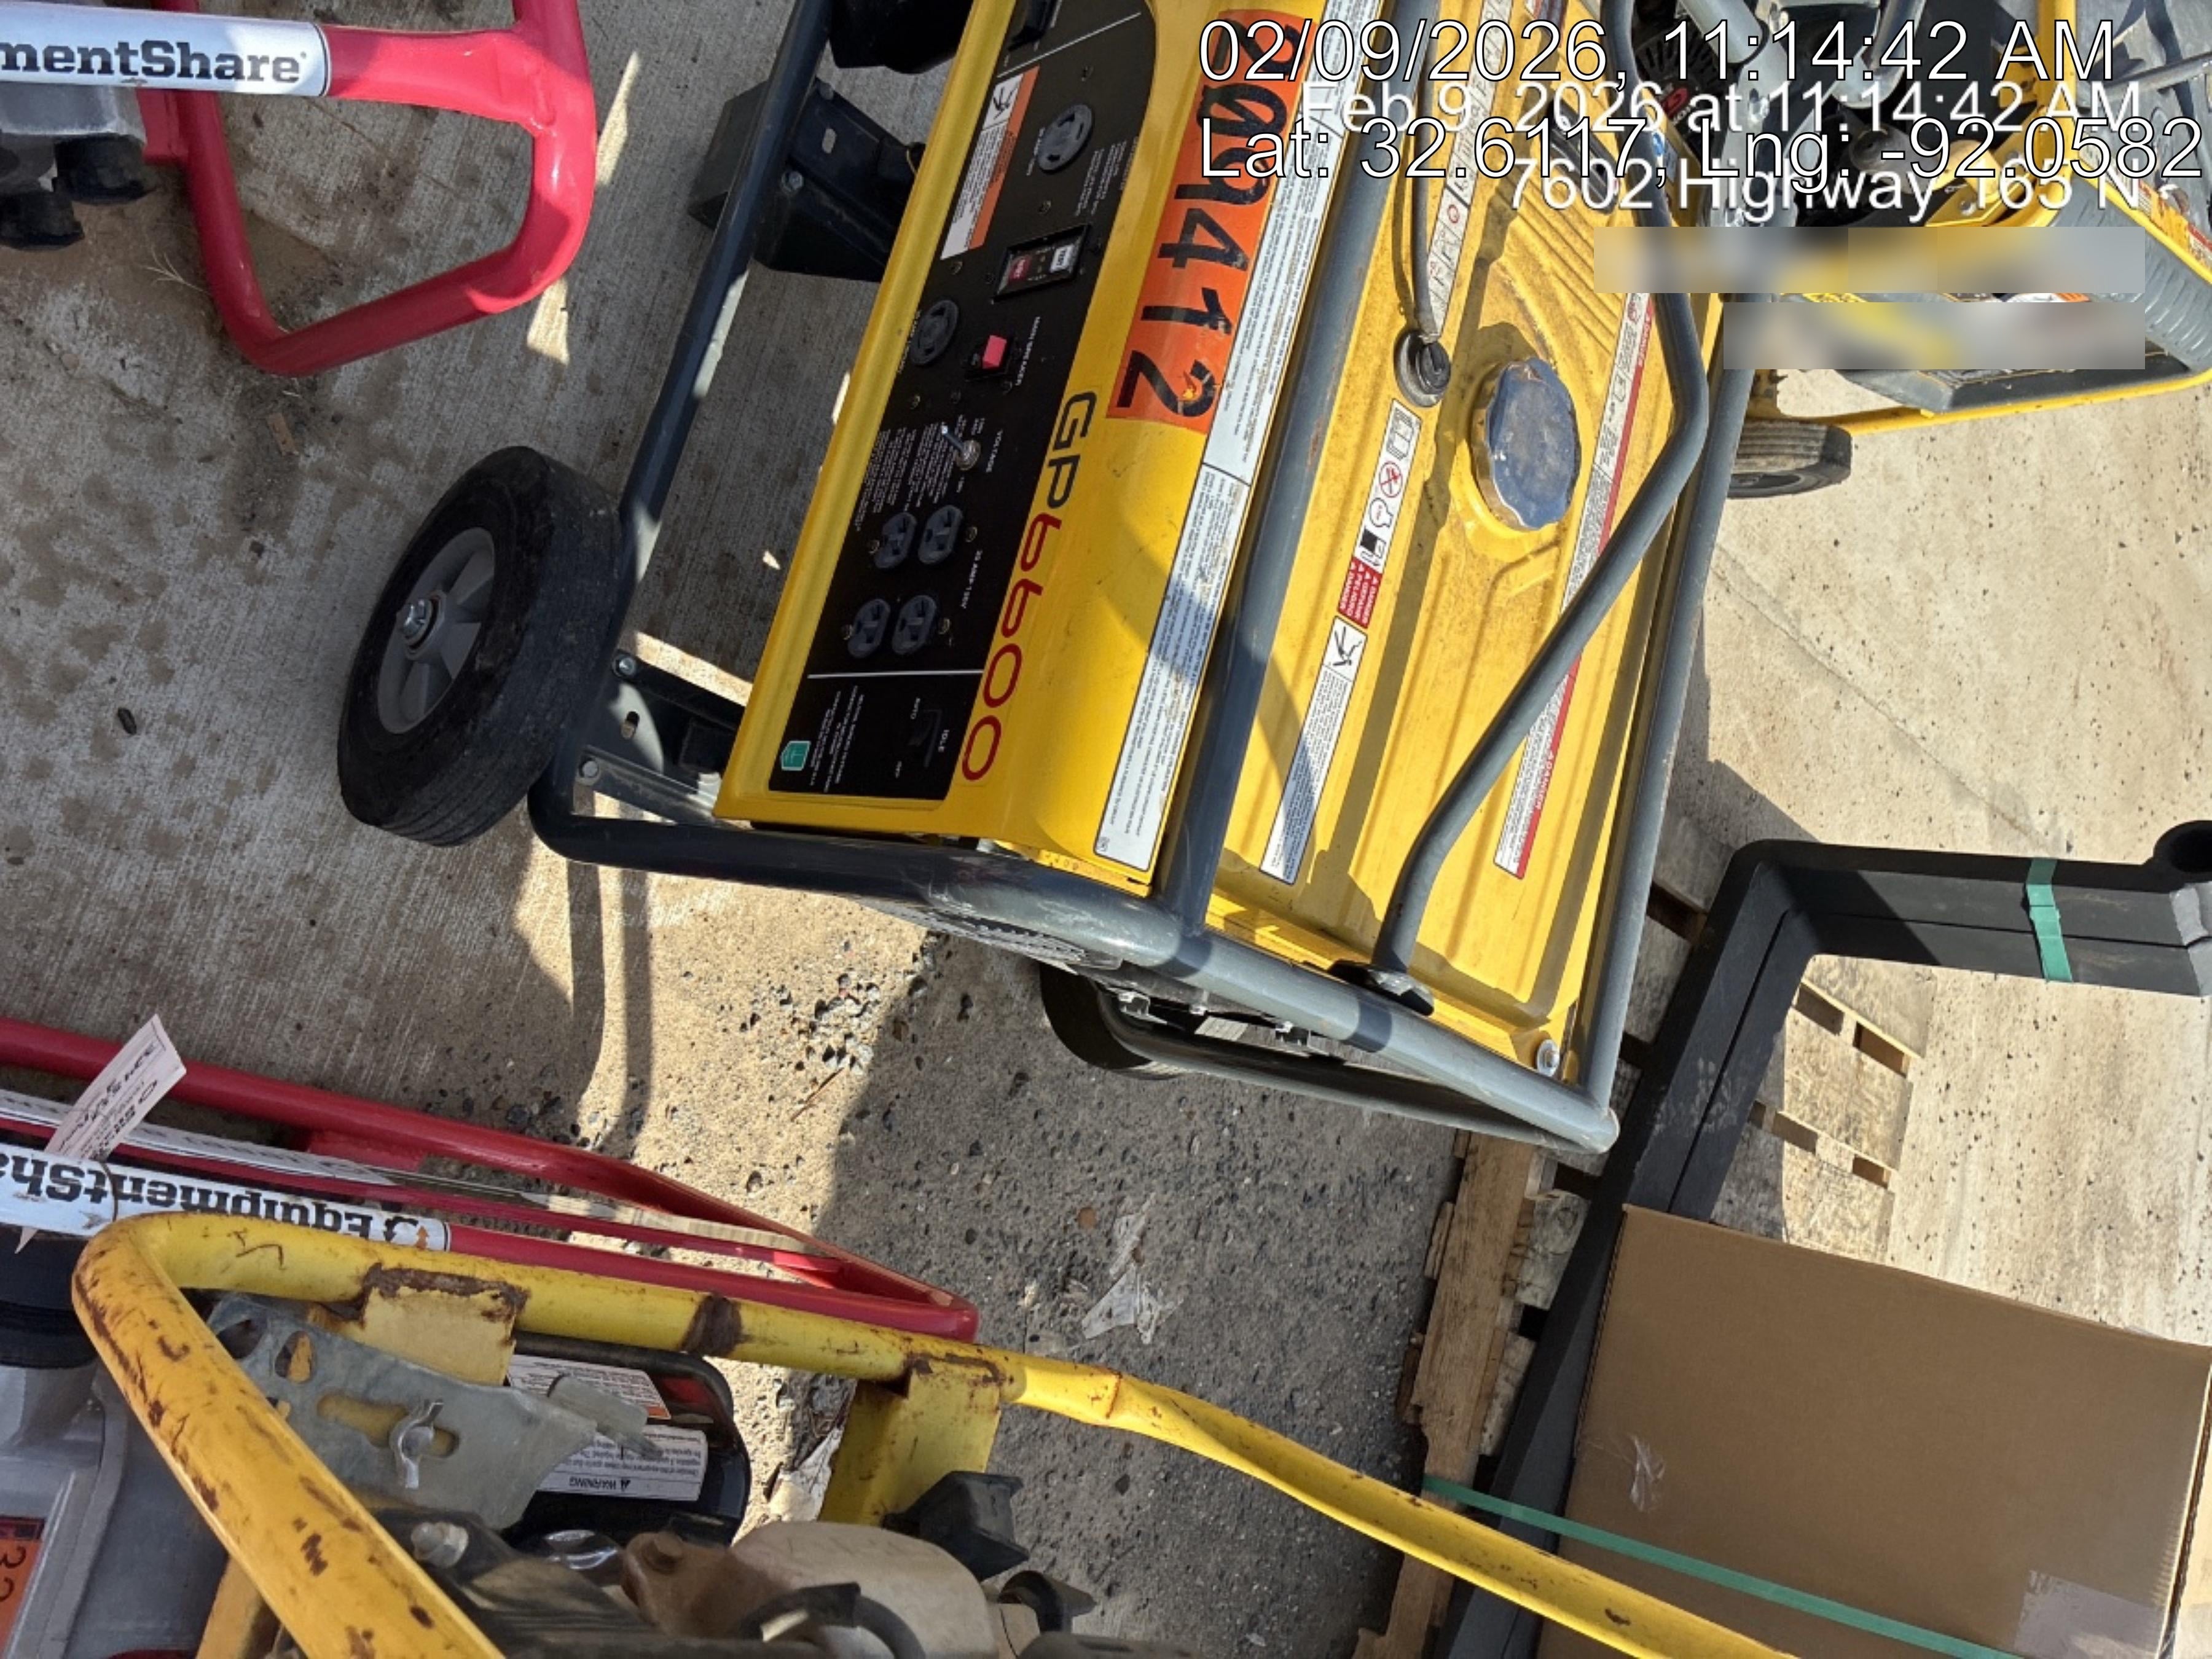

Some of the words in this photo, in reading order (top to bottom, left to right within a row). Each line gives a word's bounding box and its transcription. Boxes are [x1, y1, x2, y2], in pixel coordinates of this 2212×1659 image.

[961, 390, 1097, 781] GP6600
[938, 729, 949, 751] IDLE
[0, 1155, 373, 1240] EquipmentSh
[568, 1477, 618, 1491] WARNING
